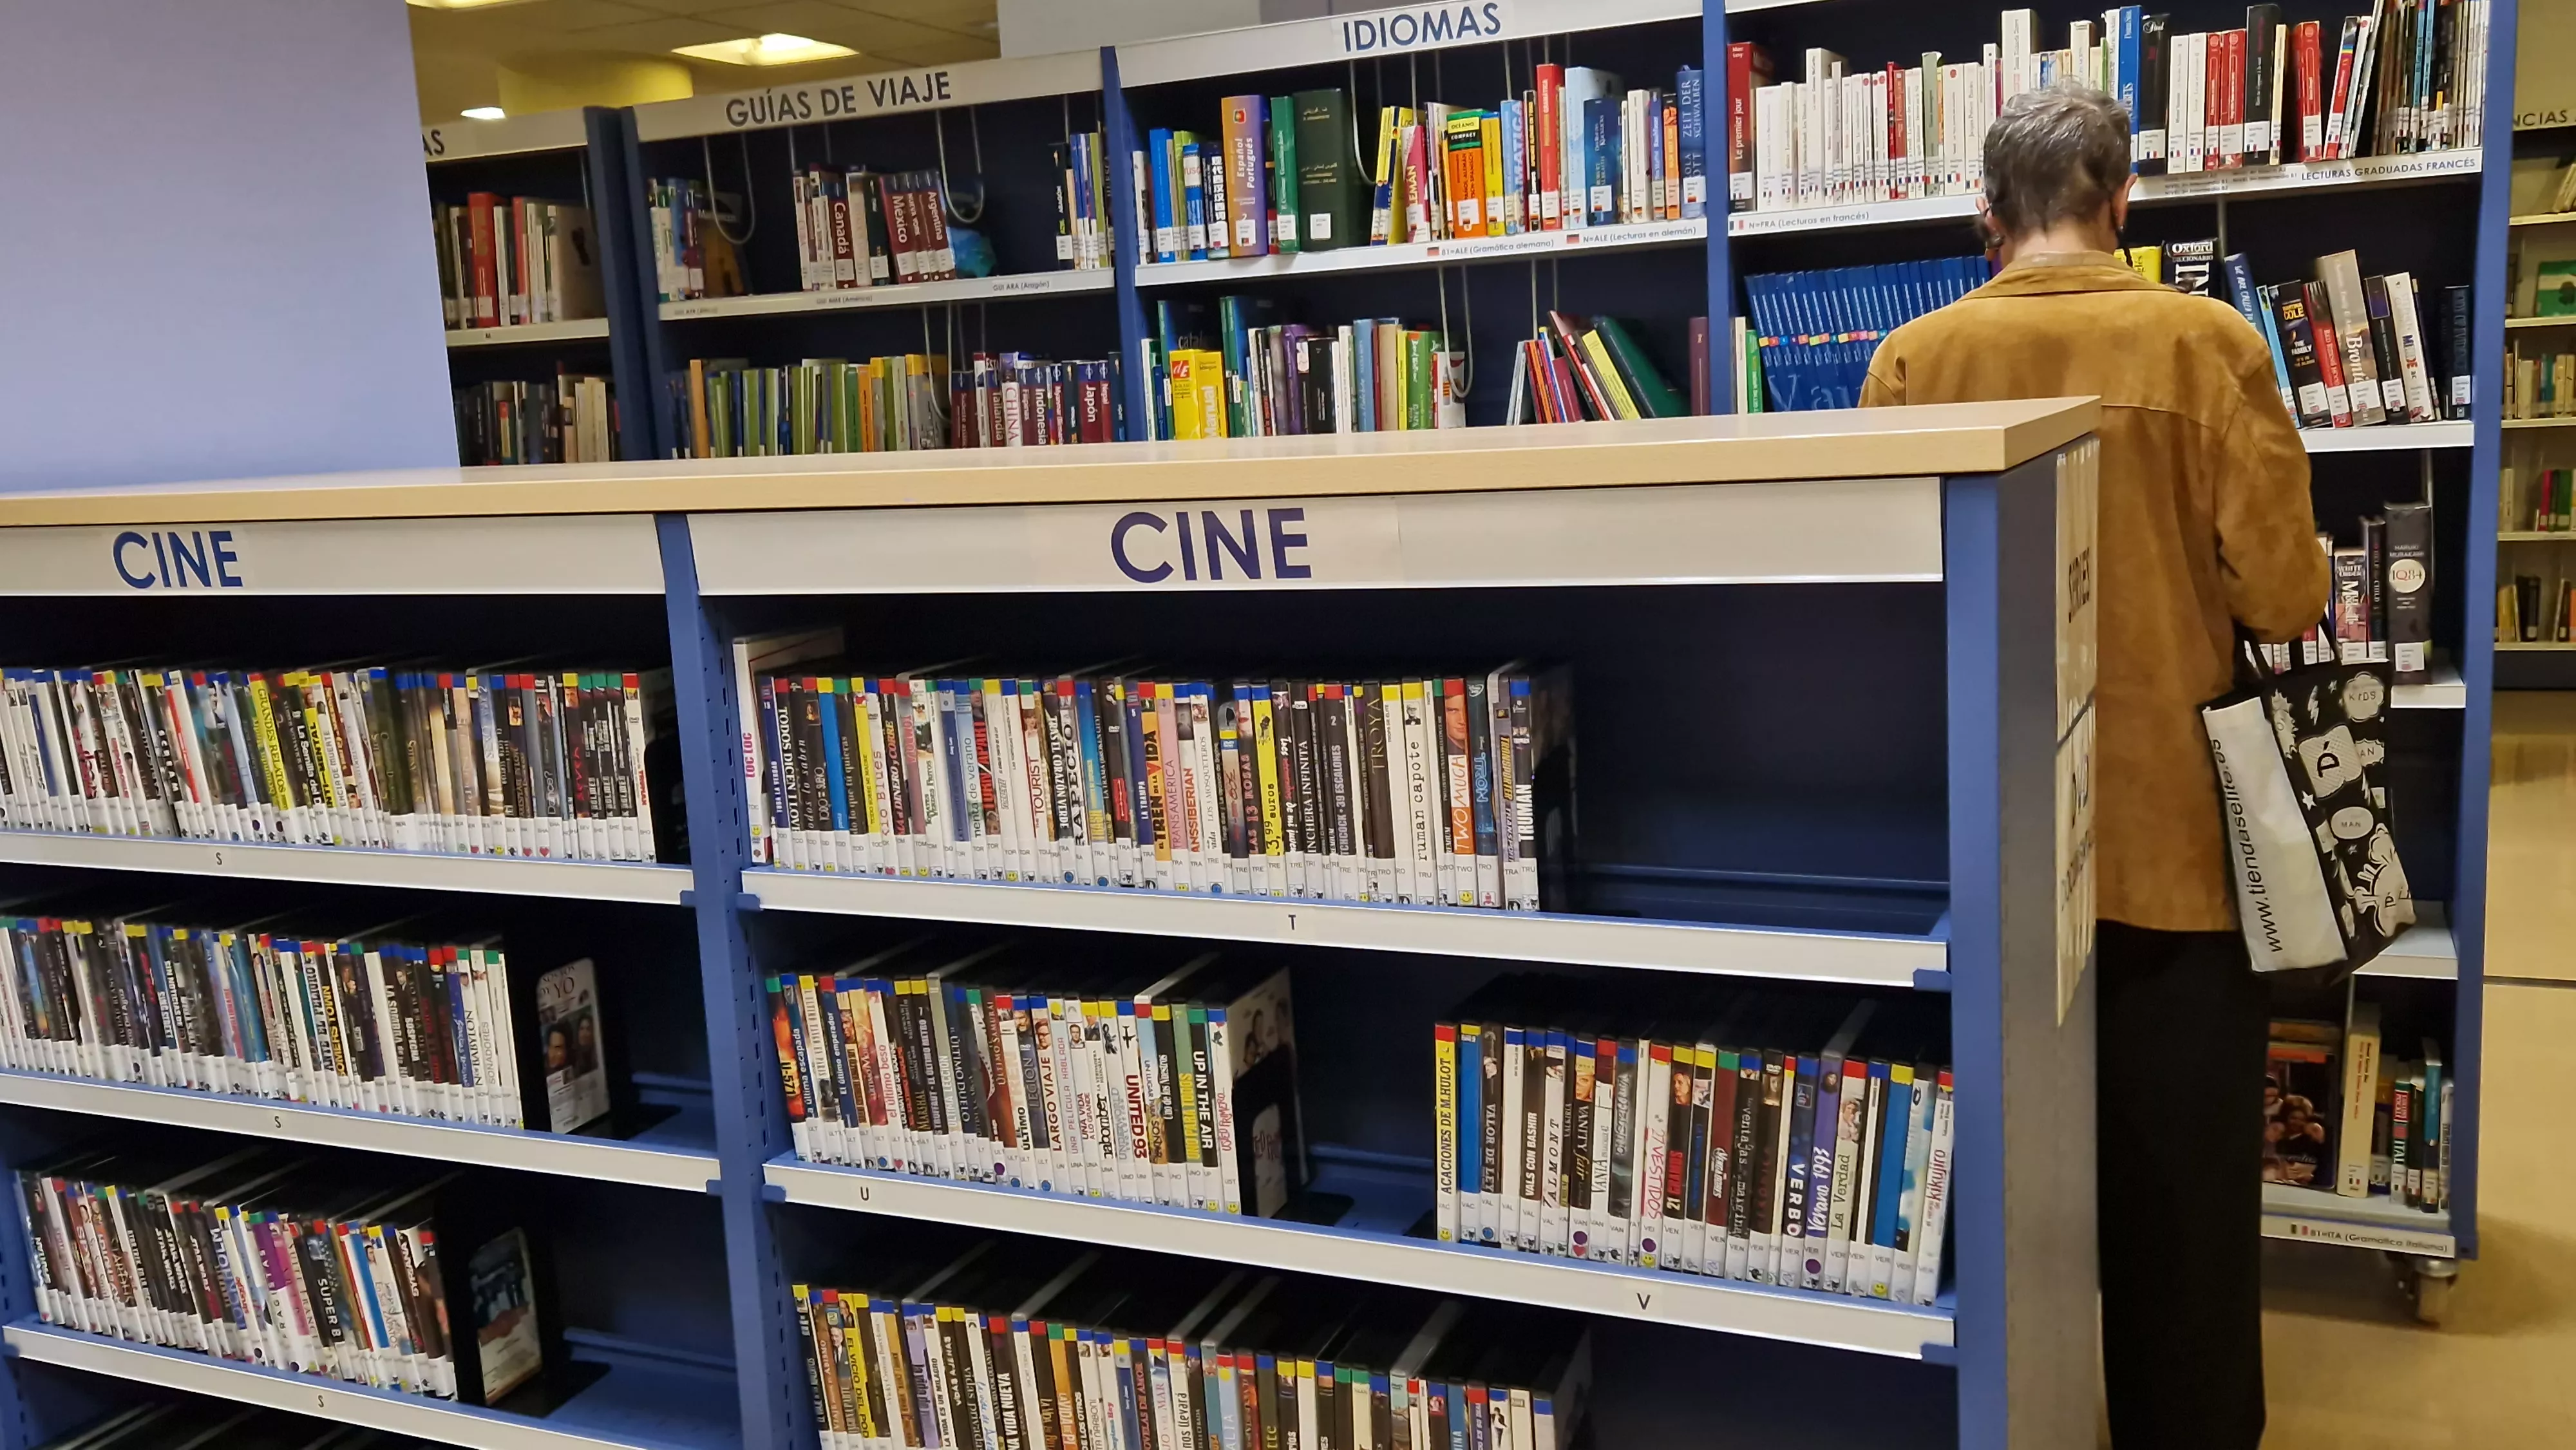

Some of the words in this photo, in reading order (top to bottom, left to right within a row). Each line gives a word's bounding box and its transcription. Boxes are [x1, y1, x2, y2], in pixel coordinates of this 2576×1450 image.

[1343, 3, 1501, 52] IDIOMAS
[726, 89, 812, 127] GUÍAS
[821, 86, 857, 117] DE
[866, 71, 952, 108] VIAJE
[1682, 80, 1691, 106] DER
[1451, 132, 1476, 140] COMPACT
[1682, 110, 1692, 137] ZEIT
[1234, 138, 1245, 177] Español
[1244, 138, 1256, 188] Portugués
[2302, 169, 2351, 180] LECTURAS
[2354, 163, 2423, 177] GRADUADAS
[2427, 158, 2476, 170] FRANCÉS
[835, 202, 849, 254] Canadá
[892, 195, 907, 243] México
[927, 191, 943, 241] Argentina
[1583, 234, 1607, 243] N=ALE
[1610, 231, 1646, 242] (Lecturas
[1662, 227, 1696, 237] alemán)
[2172, 242, 2214, 254] Oxford
[2284, 306, 2305, 320] COLE
[992, 391, 1005, 440] Tailandia
[1004, 387, 1019, 442] CHINA
[1036, 388, 1047, 445] Indonesia
[1084, 384, 1097, 422] Japón
[1202, 385, 1218, 438] Manual
[113, 531, 243, 589] CINE
[1111, 507, 1312, 583] CINE
[258, 688, 274, 742] GRANDES
[268, 744, 285, 793] RELATOS
[296, 725, 306, 739] La
[743, 732, 753, 753] toc
[1367, 697, 1386, 775] TROYA
[158, 730, 179, 792] SCREAM
[299, 741, 314, 778] Semilla
[745, 757, 755, 778] toc
[1241, 754, 1254, 799] ROSAS
[1499, 735, 1513, 801] TRANSPORTER
[309, 779, 319, 795] del
[544, 771, 556, 814] Dance?
[1029, 757, 1044, 814] TOURIST
[1448, 756, 1467, 807] MUCH
[1165, 760, 1182, 849] TRANSAMÉRICA
[1246, 805, 1258, 822] 13
[1516, 784, 1534, 842] TRUMAN
[1247, 829, 1259, 854] LAS
[1453, 808, 1470, 851] TWO
[216, 852, 223, 865] S
[1288, 914, 1297, 930] T
[166, 977, 180, 1015] NOTICIAS
[322, 985, 337, 1022] TOWN
[385, 984, 394, 997] LA
[161, 1012, 173, 1039] STREET
[388, 1000, 403, 1043] SOMBRA
[466, 1011, 483, 1064] BABYLON
[827, 1012, 841, 1056] emperador
[404, 1017, 419, 1062] SOSPECHA
[878, 1044, 889, 1069] beso
[781, 1061, 797, 1095] U-571
[835, 1059, 846, 1084] último
[1041, 1057, 1054, 1097] VIAJE
[1193, 1051, 1206, 1071] UP
[884, 1073, 896, 1106] último
[1179, 1073, 1194, 1107] TODOS
[1197, 1073, 1209, 1088] IN
[889, 1107, 897, 1118] el
[915, 1089, 930, 1129] MARSHAL
[1064, 1084, 1076, 1131] PELÍCULA
[1077, 1093, 1086, 1116] VIDA
[1126, 1075, 1144, 1136] UNITED
[1199, 1094, 1211, 1120] THE
[274, 1116, 281, 1128] S
[1018, 1107, 1030, 1151] ÚLTIMO
[1047, 1101, 1063, 1151] LARGO
[1081, 1116, 1090, 1140] UNA
[1182, 1109, 1198, 1136] PARA
[1202, 1125, 1213, 1148] AIR
[1485, 1104, 1495, 1144] VALOR
[1526, 1112, 1537, 1148] BASHIR
[1651, 1127, 1665, 1144] 27
[1070, 1136, 1079, 1154] UNA
[1132, 1138, 1147, 1158] 93
[1185, 1138, 1200, 1159] UNO
[1485, 1148, 1495, 1164] DE
[1526, 1150, 1536, 1170] CON
[1485, 1167, 1495, 1192] LEY
[1812, 1146, 1832, 1180] 1993
[1833, 1154, 1851, 1203] Verdad
[1926, 1149, 1947, 1201] kikujiro
[860, 1187, 869, 1201] U
[1525, 1172, 1535, 1196] VALS
[1647, 1145, 1663, 1219] VESTIDOS
[1786, 1163, 1806, 1236] VERBO
[1806, 1185, 1830, 1232] Verano
[1830, 1213, 1844, 1230] La
[155, 1228, 167, 1261] STAR
[163, 1261, 177, 1291] WARS
[165, 1229, 178, 1263] STAR
[173, 1262, 187, 1295] WARS
[190, 1235, 202, 1263] STAR
[196, 1264, 211, 1293] WARS
[1636, 1292, 1651, 1310] V
[932, 1358, 942, 1392] MILAGRO
[997, 1372, 1013, 1409] NUEVA
[318, 1395, 325, 1408] S
[936, 1394, 943, 1405] UN
[938, 1406, 946, 1416] ES
[1155, 1382, 1167, 1410] MAR
[1175, 1392, 1189, 1427] llevará
[940, 1418, 949, 1436] VIDA
[1004, 1409, 1018, 1435] VIDA
[943, 1437, 951, 1447] LA
[1180, 1431, 1191, 1449] nos
